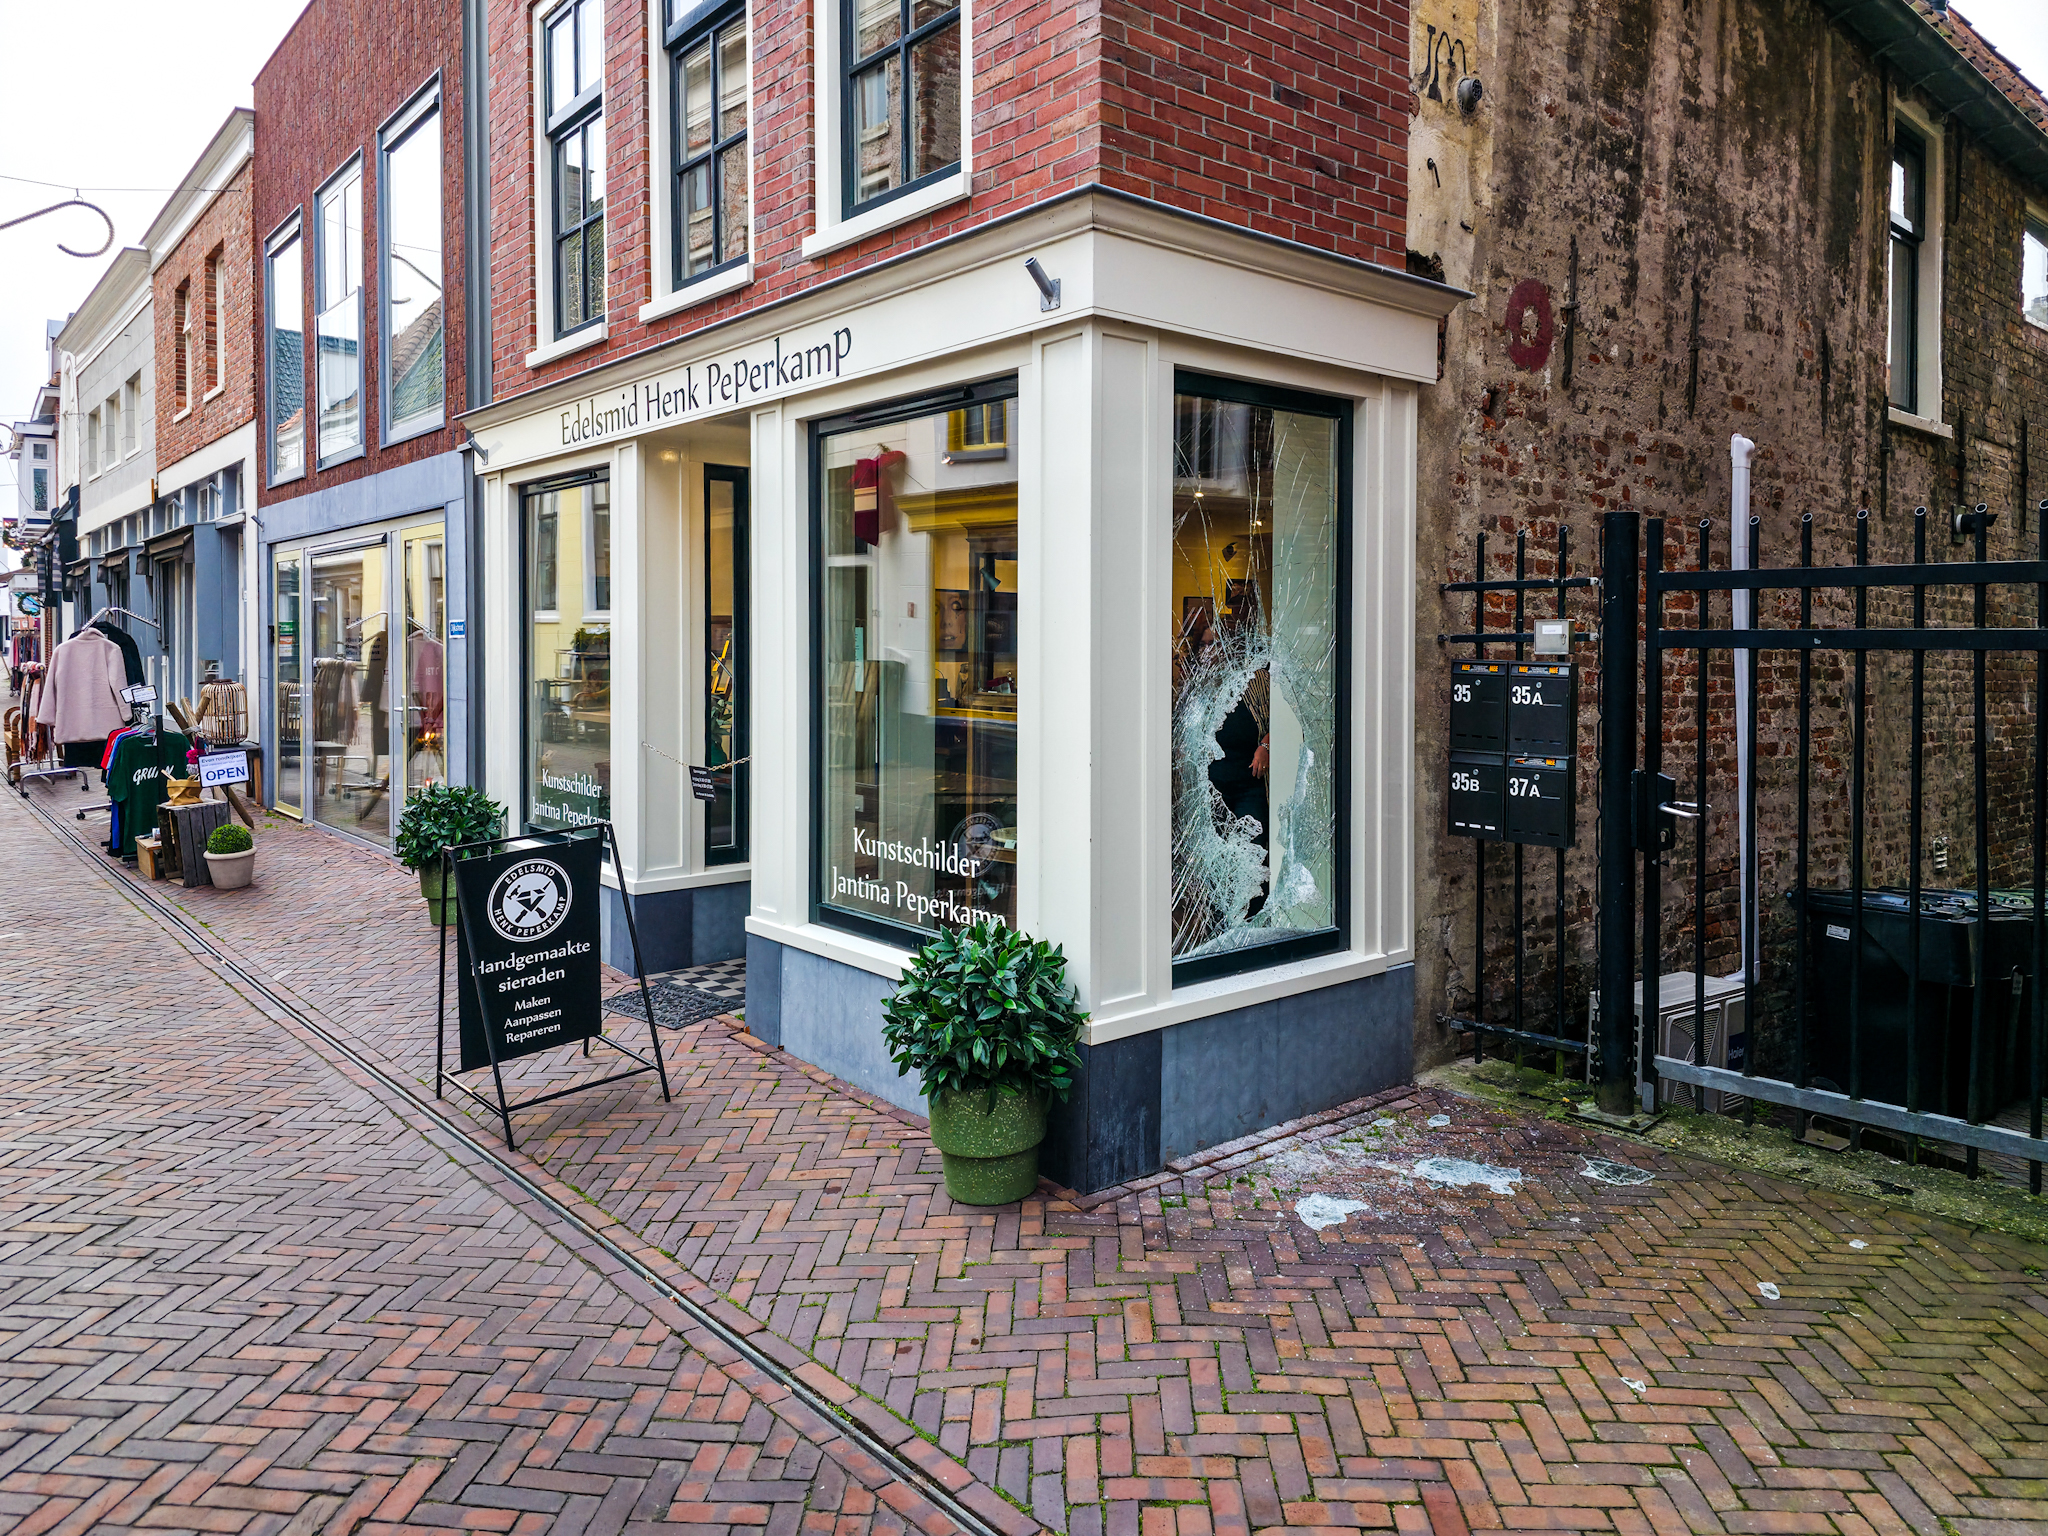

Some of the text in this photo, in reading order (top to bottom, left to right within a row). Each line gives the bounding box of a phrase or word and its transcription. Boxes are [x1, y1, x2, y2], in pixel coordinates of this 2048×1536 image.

[560, 384, 638, 446] Edelsmid
[645, 366, 700, 422] Henk
[1453, 684, 1471, 703] 35
[205, 766, 246, 781] OPEN
[542, 768, 603, 798] Kunstschilder
[531, 796, 561, 820] Jantina
[853, 826, 981, 879] Kunstschilder
[504, 864, 556, 885] EDELSMID
[831, 866, 890, 906] Jantina
[494, 896, 566, 936] HENK PEPERKAMP
[498, 967, 566, 993] sieraden
[514, 996, 551, 1012] Maken
[504, 1009, 562, 1030] Aanpassen
[506, 1023, 561, 1044] Repareren
